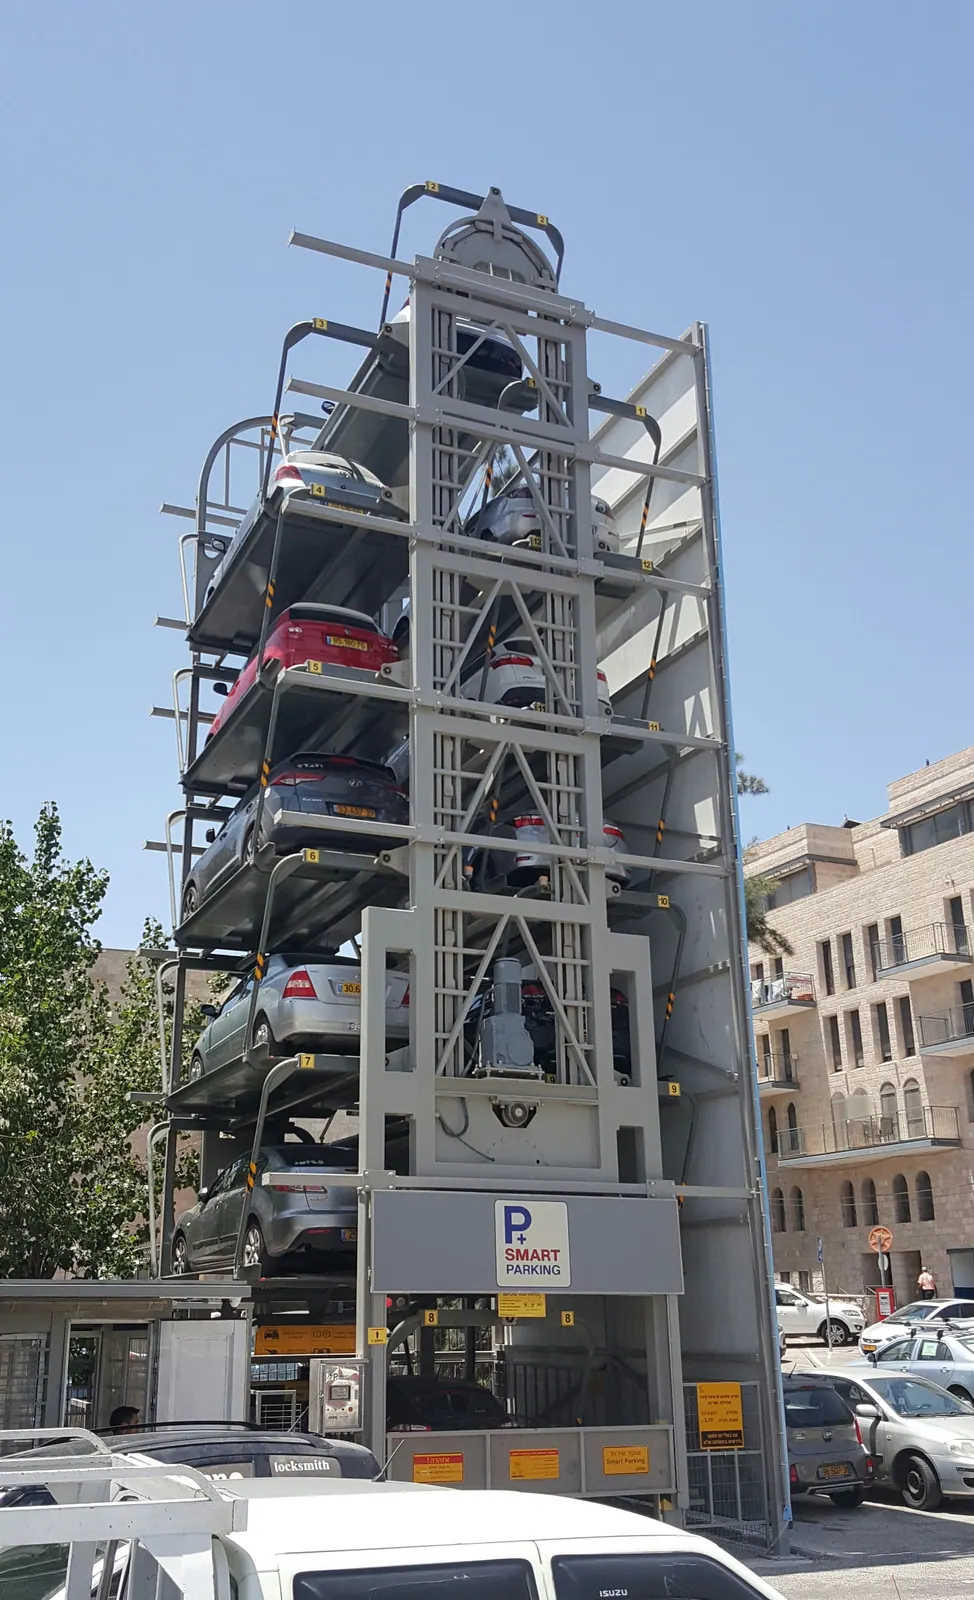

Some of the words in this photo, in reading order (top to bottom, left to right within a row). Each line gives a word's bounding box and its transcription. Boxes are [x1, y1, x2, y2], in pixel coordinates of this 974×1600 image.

[318, 320, 324, 328] 3
[316, 486, 322, 494] 4
[533, 537, 541, 545] 12
[643, 560, 651, 568] 12
[650, 723, 658, 731] 11
[310, 852, 316, 860] 6
[659, 897, 668, 905] 10
[304, 1056, 311, 1065] 7
[671, 1085, 677, 1093] 9
[505, 1247, 560, 1262] SMART
[506, 1264, 561, 1275] PARKING
[429, 1312, 435, 1322] 8
[565, 1313, 571, 1323] 8
[625, 1457, 645, 1465] Parking
[274, 1459, 330, 1472] locksmith
[599, 1589, 628, 1598] ISUZU
